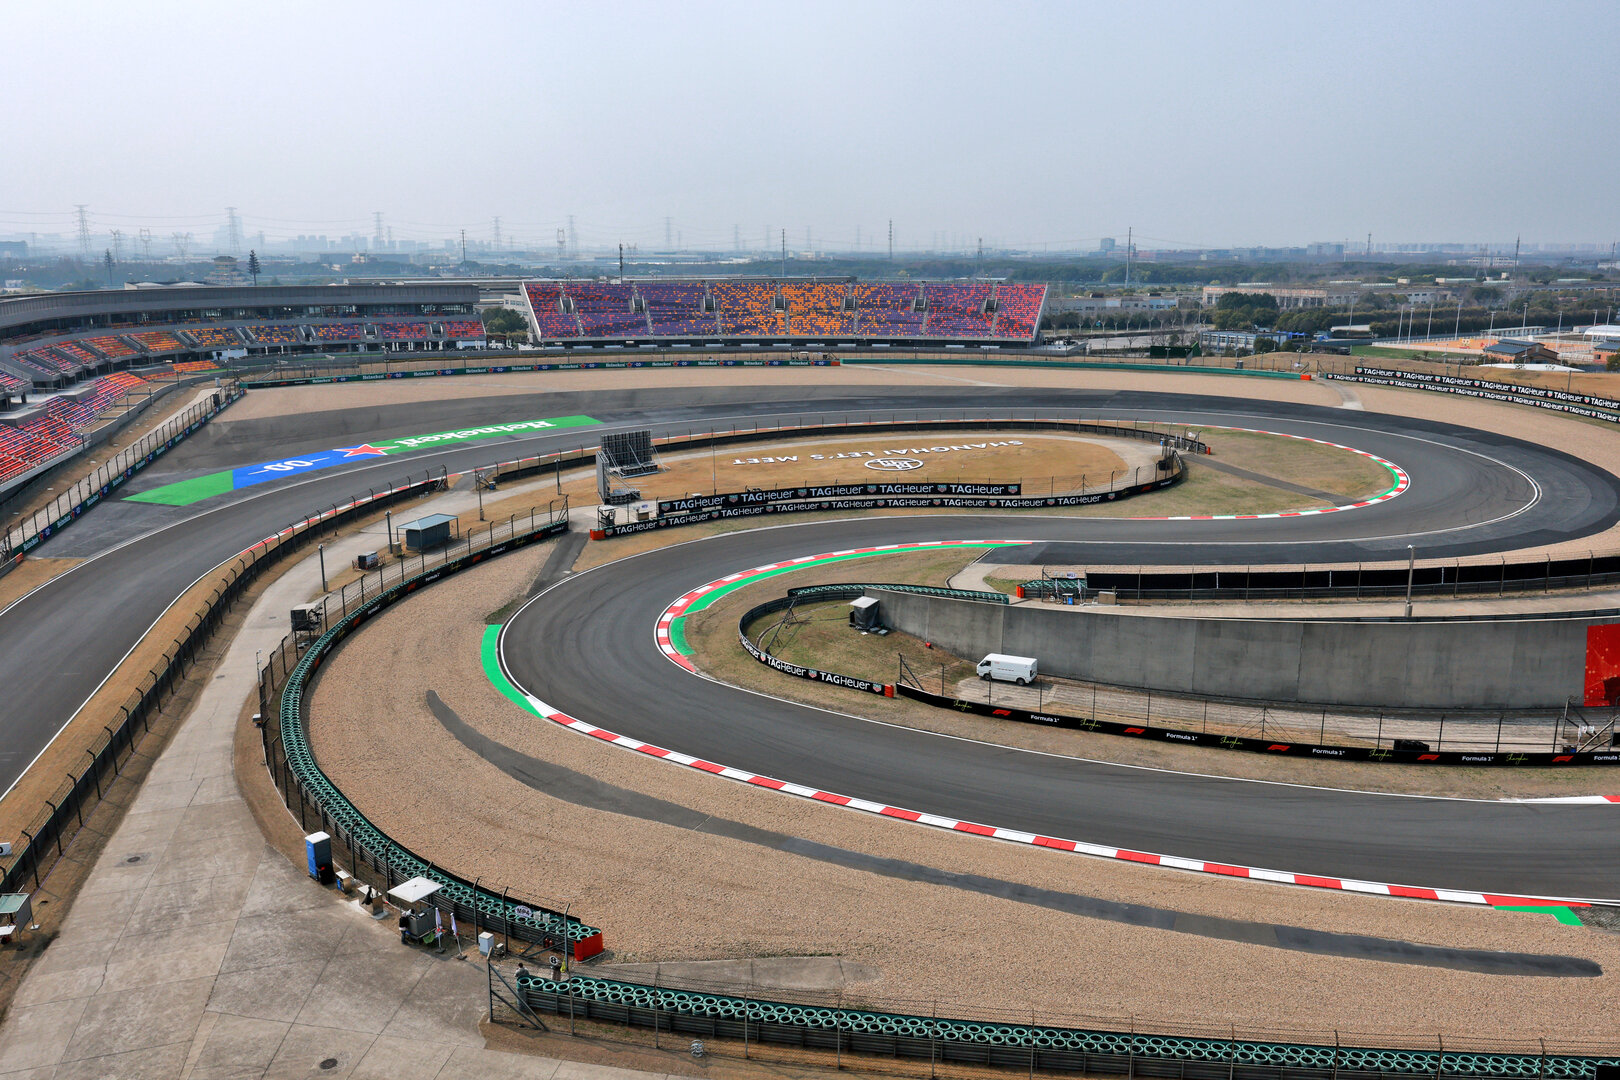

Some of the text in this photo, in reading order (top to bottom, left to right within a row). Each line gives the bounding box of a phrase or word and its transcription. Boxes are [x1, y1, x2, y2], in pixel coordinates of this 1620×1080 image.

[1364, 368, 1620, 408] TAGHeuer TAGHeuer TAGHeuer TAGHeuer TAGHeuer TAGHeuer TAGHeuer
[733, 455, 798, 465] MEET
[883, 440, 1024, 456] SHANGHAI
[673, 497, 725, 510] TAGHeuer
[741, 490, 794, 502] TAGHeuer
[810, 486, 863, 496] TAGHeuer
[880, 485, 934, 493] TAGHeuer
[950, 485, 1004, 494] TAGHeuer
[615, 521, 657, 534] TAGHeuer
[668, 512, 710, 525] TAGHeuer
[721, 506, 764, 517] TAGHeuer
[776, 503, 819, 512] TAGHeuer
[1057, 495, 1101, 505] TAGHeuer
[767, 656, 806, 676] TAGHeuer
[820, 672, 870, 690] TAGHeuer
